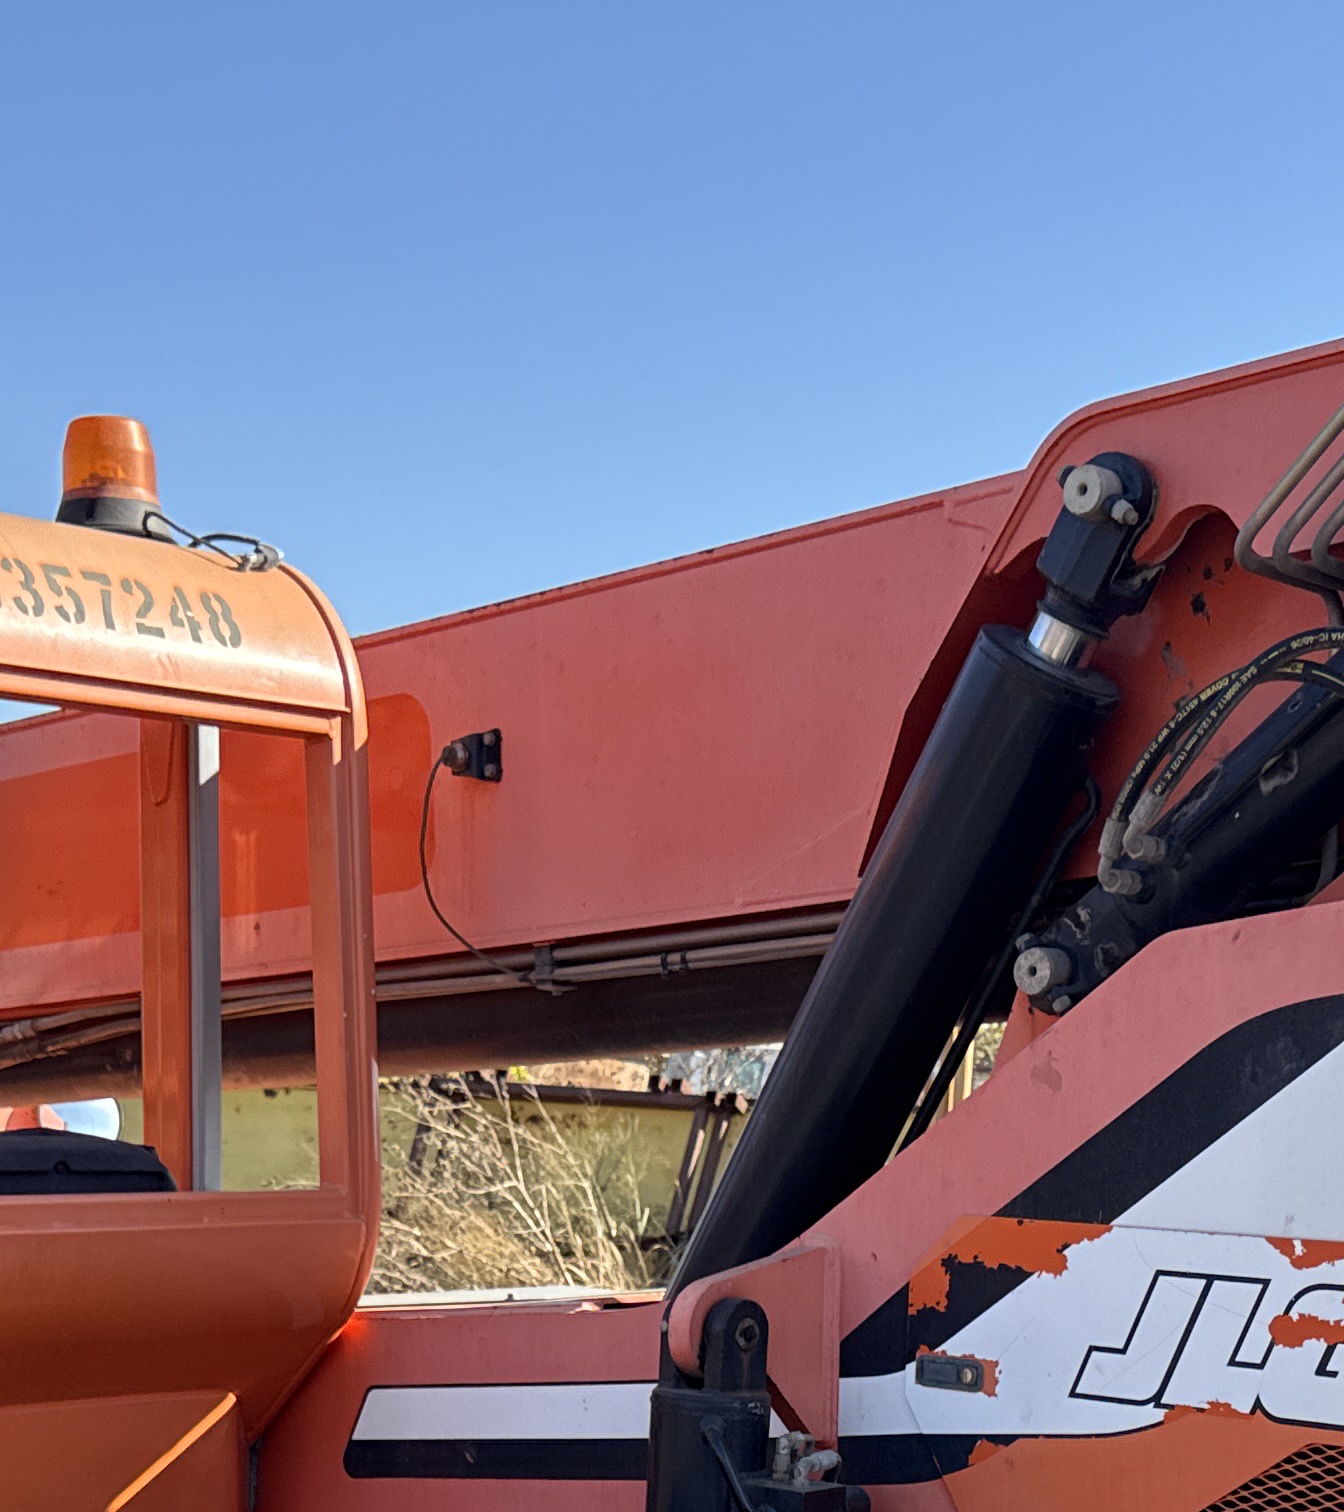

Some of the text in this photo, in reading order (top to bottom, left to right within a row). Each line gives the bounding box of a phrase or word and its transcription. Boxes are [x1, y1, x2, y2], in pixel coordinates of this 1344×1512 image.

[1238, 665, 1257, 682] SAE
[1198, 676, 1229, 701] COVER
[1196, 717, 1210, 734] 12.5
[1155, 727, 1170, 743] WP
[1184, 734, 1198, 750] mm
